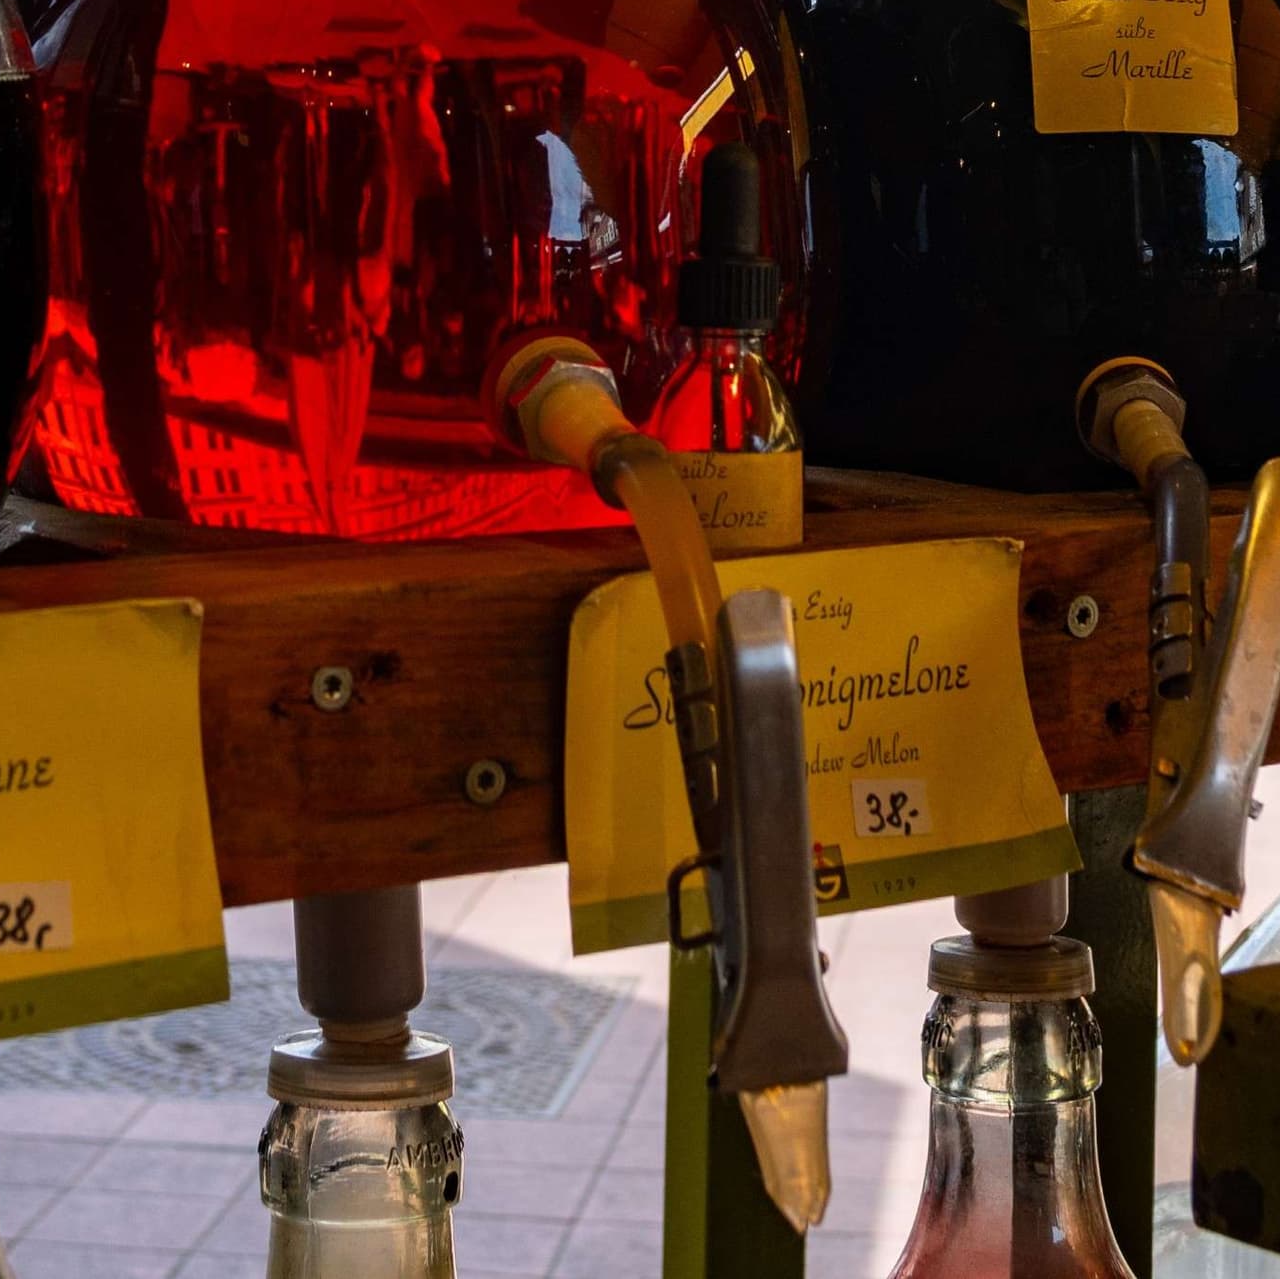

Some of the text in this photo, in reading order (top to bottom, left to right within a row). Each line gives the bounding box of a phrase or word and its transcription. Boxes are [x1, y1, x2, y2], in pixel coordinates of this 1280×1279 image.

[1115, 16, 1157, 40] süße
[1080, 49, 1194, 81] Marille
[692, 489, 769, 530] elone
[803, 590, 854, 631] Essig
[851, 732, 921, 768] Melon
[865, 790, 920, 837] 38,-
[872, 876, 919, 895] 1929
